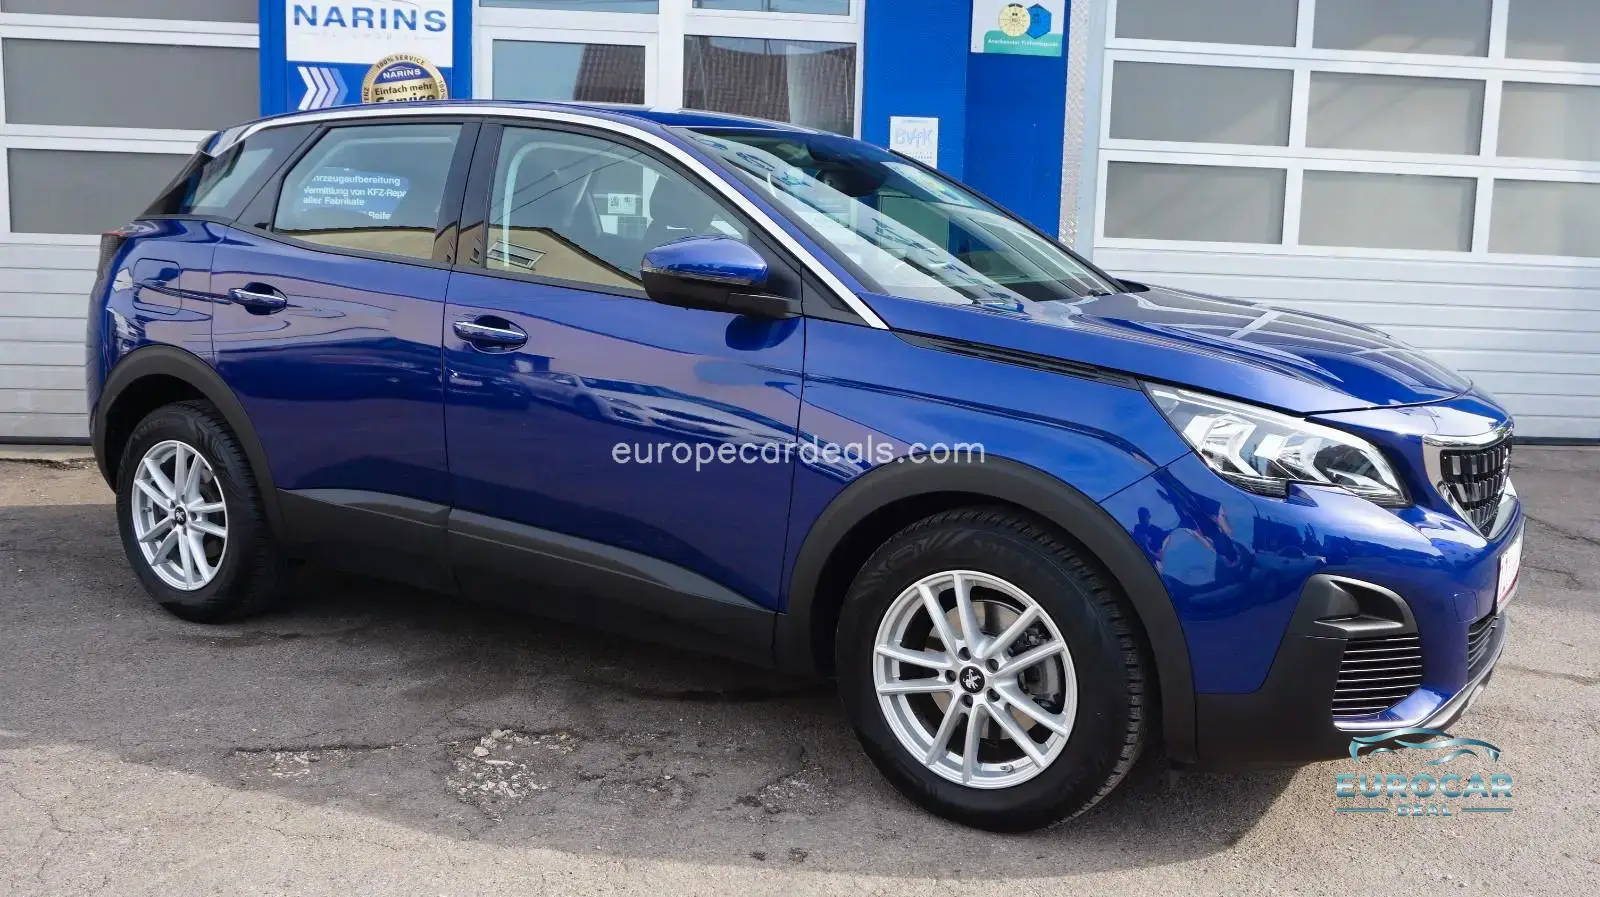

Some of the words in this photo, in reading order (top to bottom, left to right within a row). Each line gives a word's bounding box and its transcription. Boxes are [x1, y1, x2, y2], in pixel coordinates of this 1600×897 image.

[294, 4, 447, 32] NARINS
[395, 54, 424, 65] SERVICE
[383, 68, 421, 79] NARINS
[375, 84, 408, 96] Einfach
[410, 82, 433, 92] mehr
[350, 188, 366, 196] von
[303, 196, 322, 204] aller
[324, 197, 365, 206] Fabrikate
